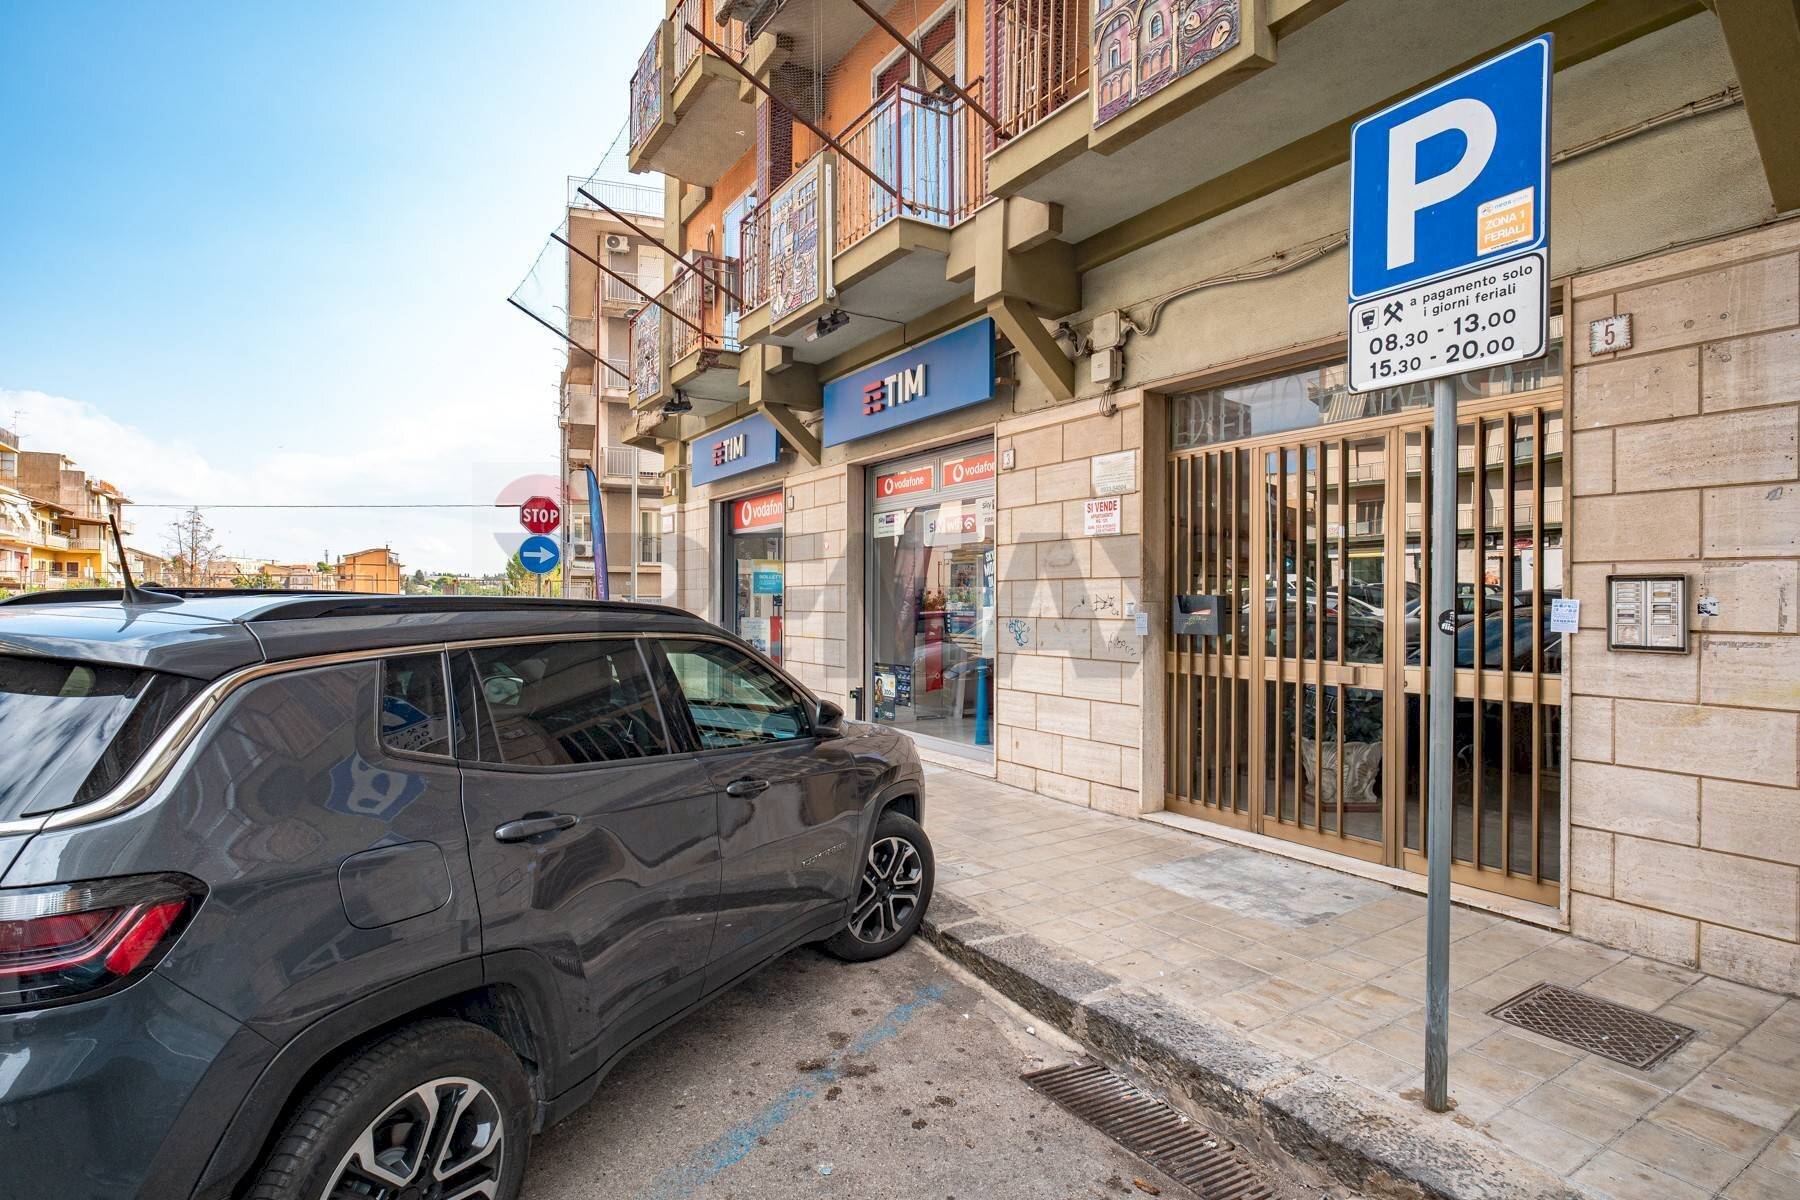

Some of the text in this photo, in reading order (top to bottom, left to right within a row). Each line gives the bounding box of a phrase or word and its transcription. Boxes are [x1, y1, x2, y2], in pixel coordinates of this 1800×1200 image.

[1386, 98, 1497, 270] P
[1485, 209, 1525, 230] ZONA 1
[1484, 222, 1525, 244] FERIALI
[1409, 265, 1533, 306] a pagamento solo
[1423, 283, 1516, 317] i giorni feriali
[1604, 322, 1615, 345] 5
[884, 363, 928, 407] TIM
[723, 433, 747, 463] TIM
[894, 475, 925, 489] vodafone
[523, 507, 559, 524] STOP
[1087, 500, 1118, 514] SI VENDE
